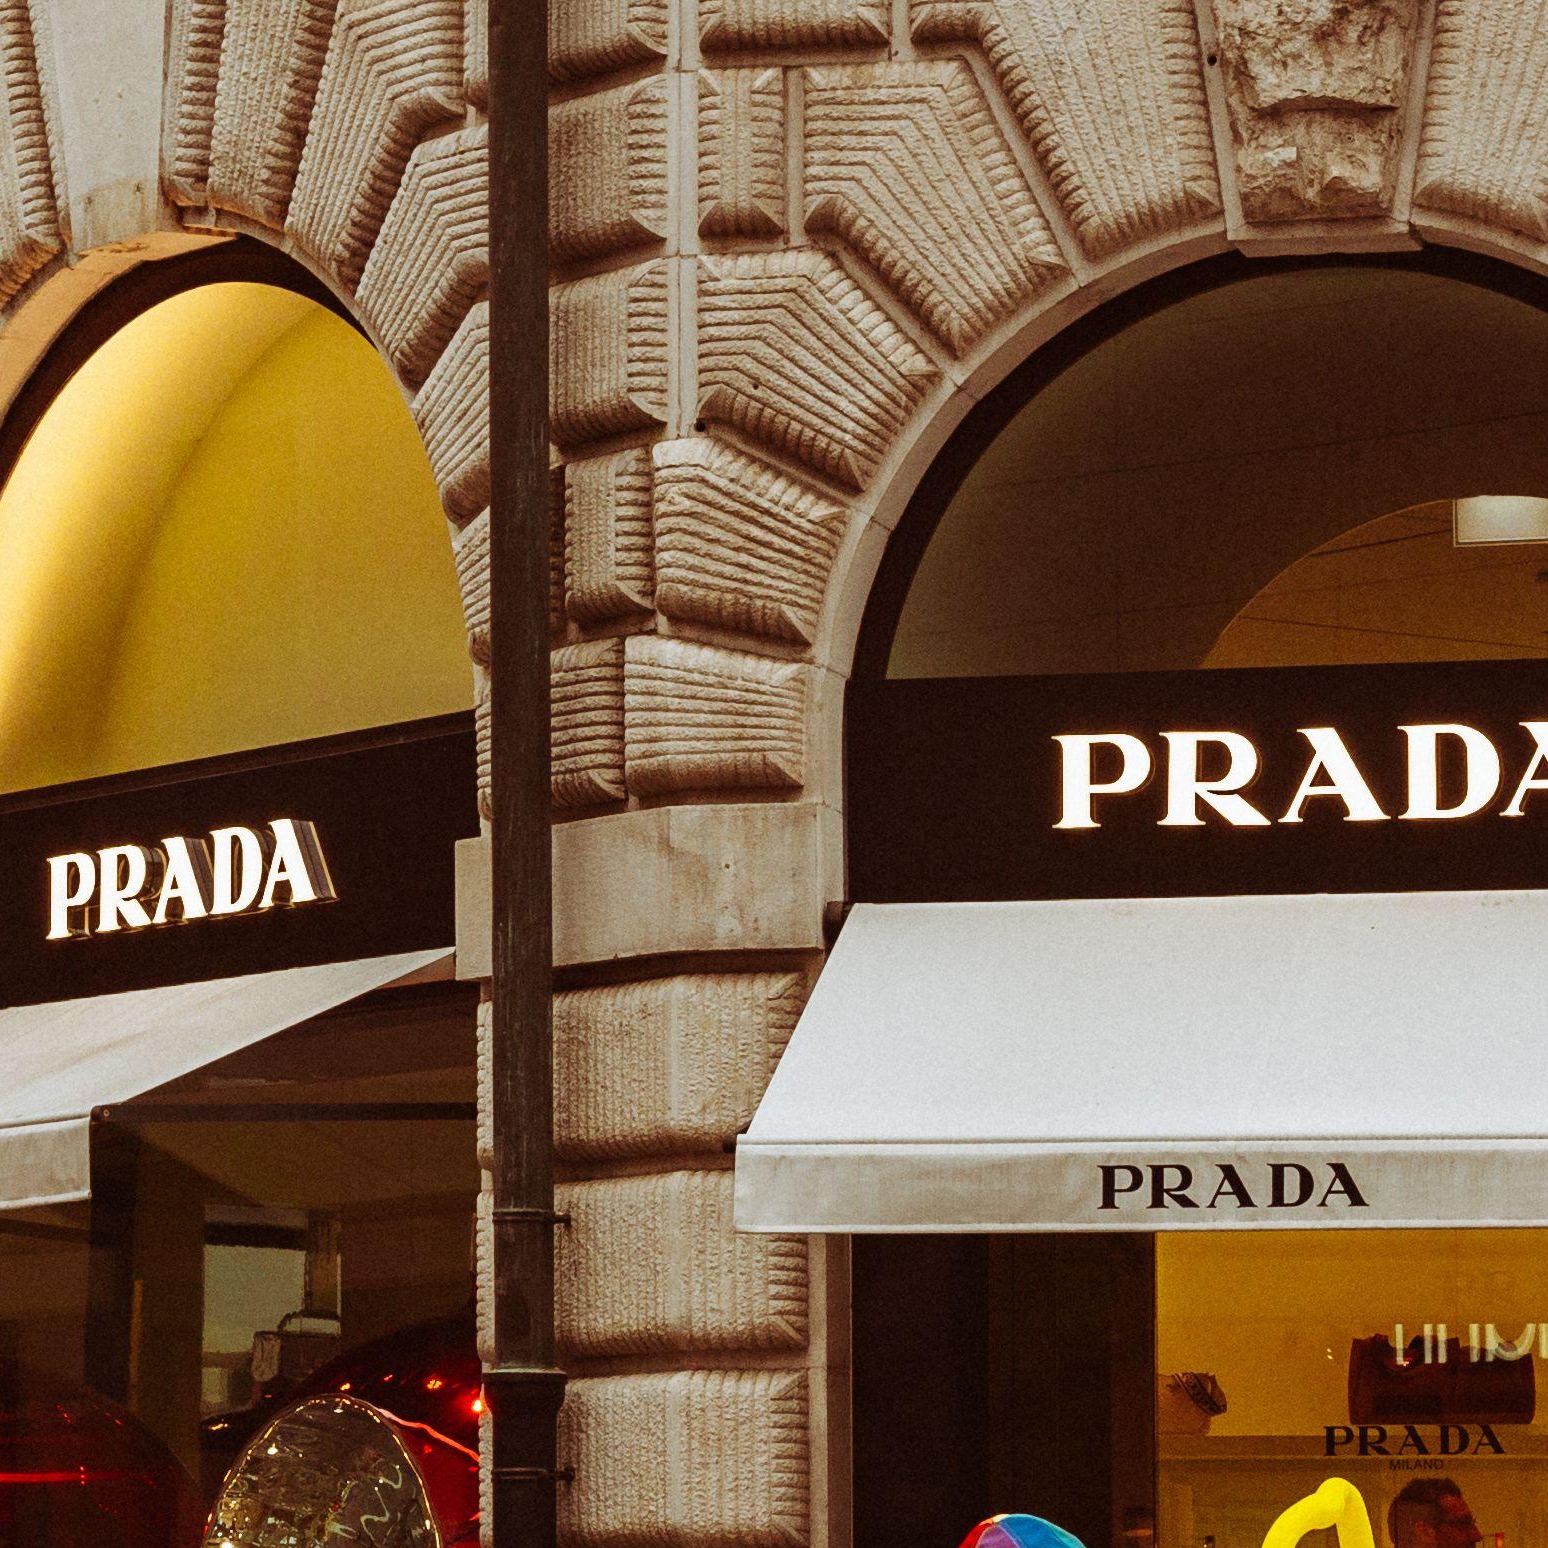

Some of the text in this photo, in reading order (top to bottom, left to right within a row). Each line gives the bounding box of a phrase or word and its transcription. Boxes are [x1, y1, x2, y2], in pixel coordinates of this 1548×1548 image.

[47, 817, 320, 940] PRADA
[1096, 1162, 1371, 1211] PRADA
[1322, 1423, 1506, 1457] PRADA
[1388, 1458, 1445, 1471] MILANO
